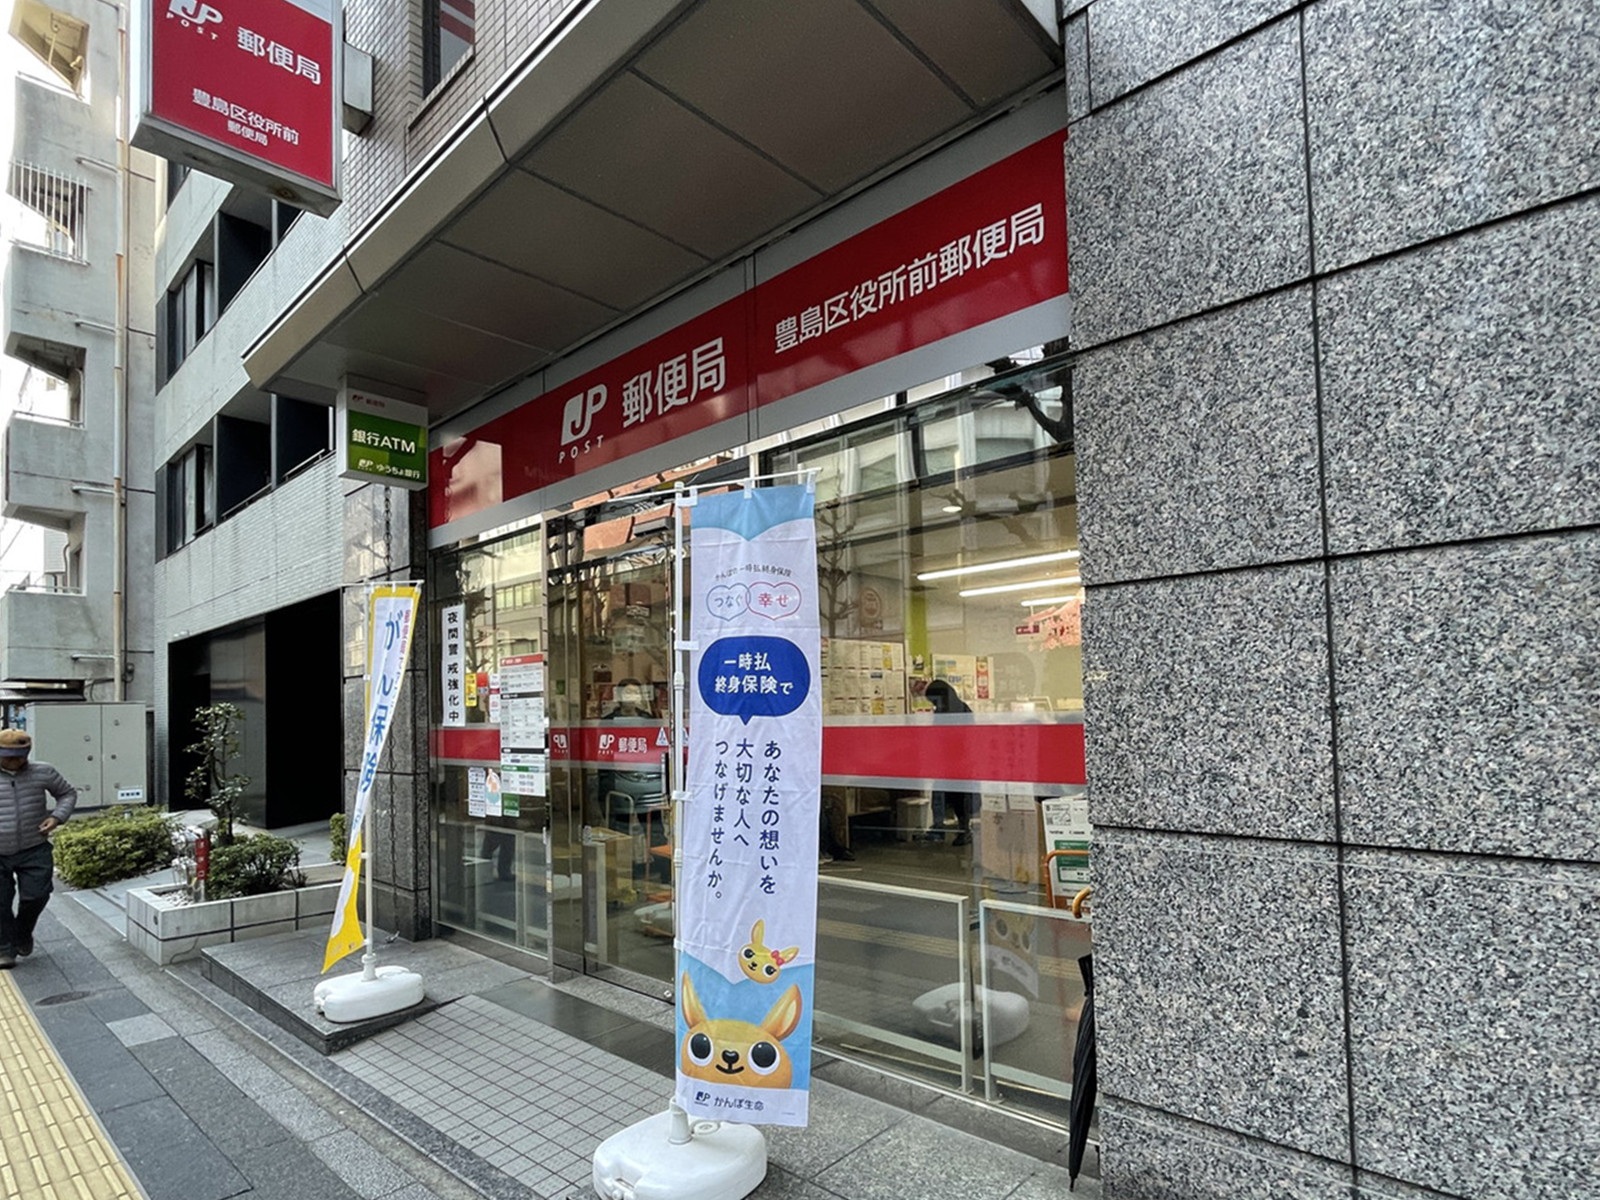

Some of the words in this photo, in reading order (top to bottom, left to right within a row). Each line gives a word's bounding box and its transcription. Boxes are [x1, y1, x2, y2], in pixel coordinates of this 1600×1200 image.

[166, 12, 218, 40] POST
[237, 26, 322, 85] 郵便局
[192, 87, 299, 145] 豊島区役所前
[227, 119, 268, 147] 郵便局
[774, 202, 1045, 354] 豊島区役所前郵便局
[560, 383, 608, 446] JP
[622, 336, 726, 429] 郵便局
[351, 428, 416, 454] 銀行ATM
[558, 434, 604, 465] POST
[376, 463, 420, 479] ゆうちょ銀行
[714, 593, 743, 608] つなぐ
[757, 592, 789, 608] 幸せ
[447, 611, 460, 723] 夜間警戒強化中
[723, 652, 772, 671] 一時払
[714, 674, 794, 695] 終身保険で
[618, 737, 648, 754] 郵便局
[733, 738, 754, 847] 大切な人へ
[707, 740, 729, 899] つなげませんか。
[759, 740, 782, 894] あなたの想いを
[714, 1096, 764, 1112] かんぽ生命
